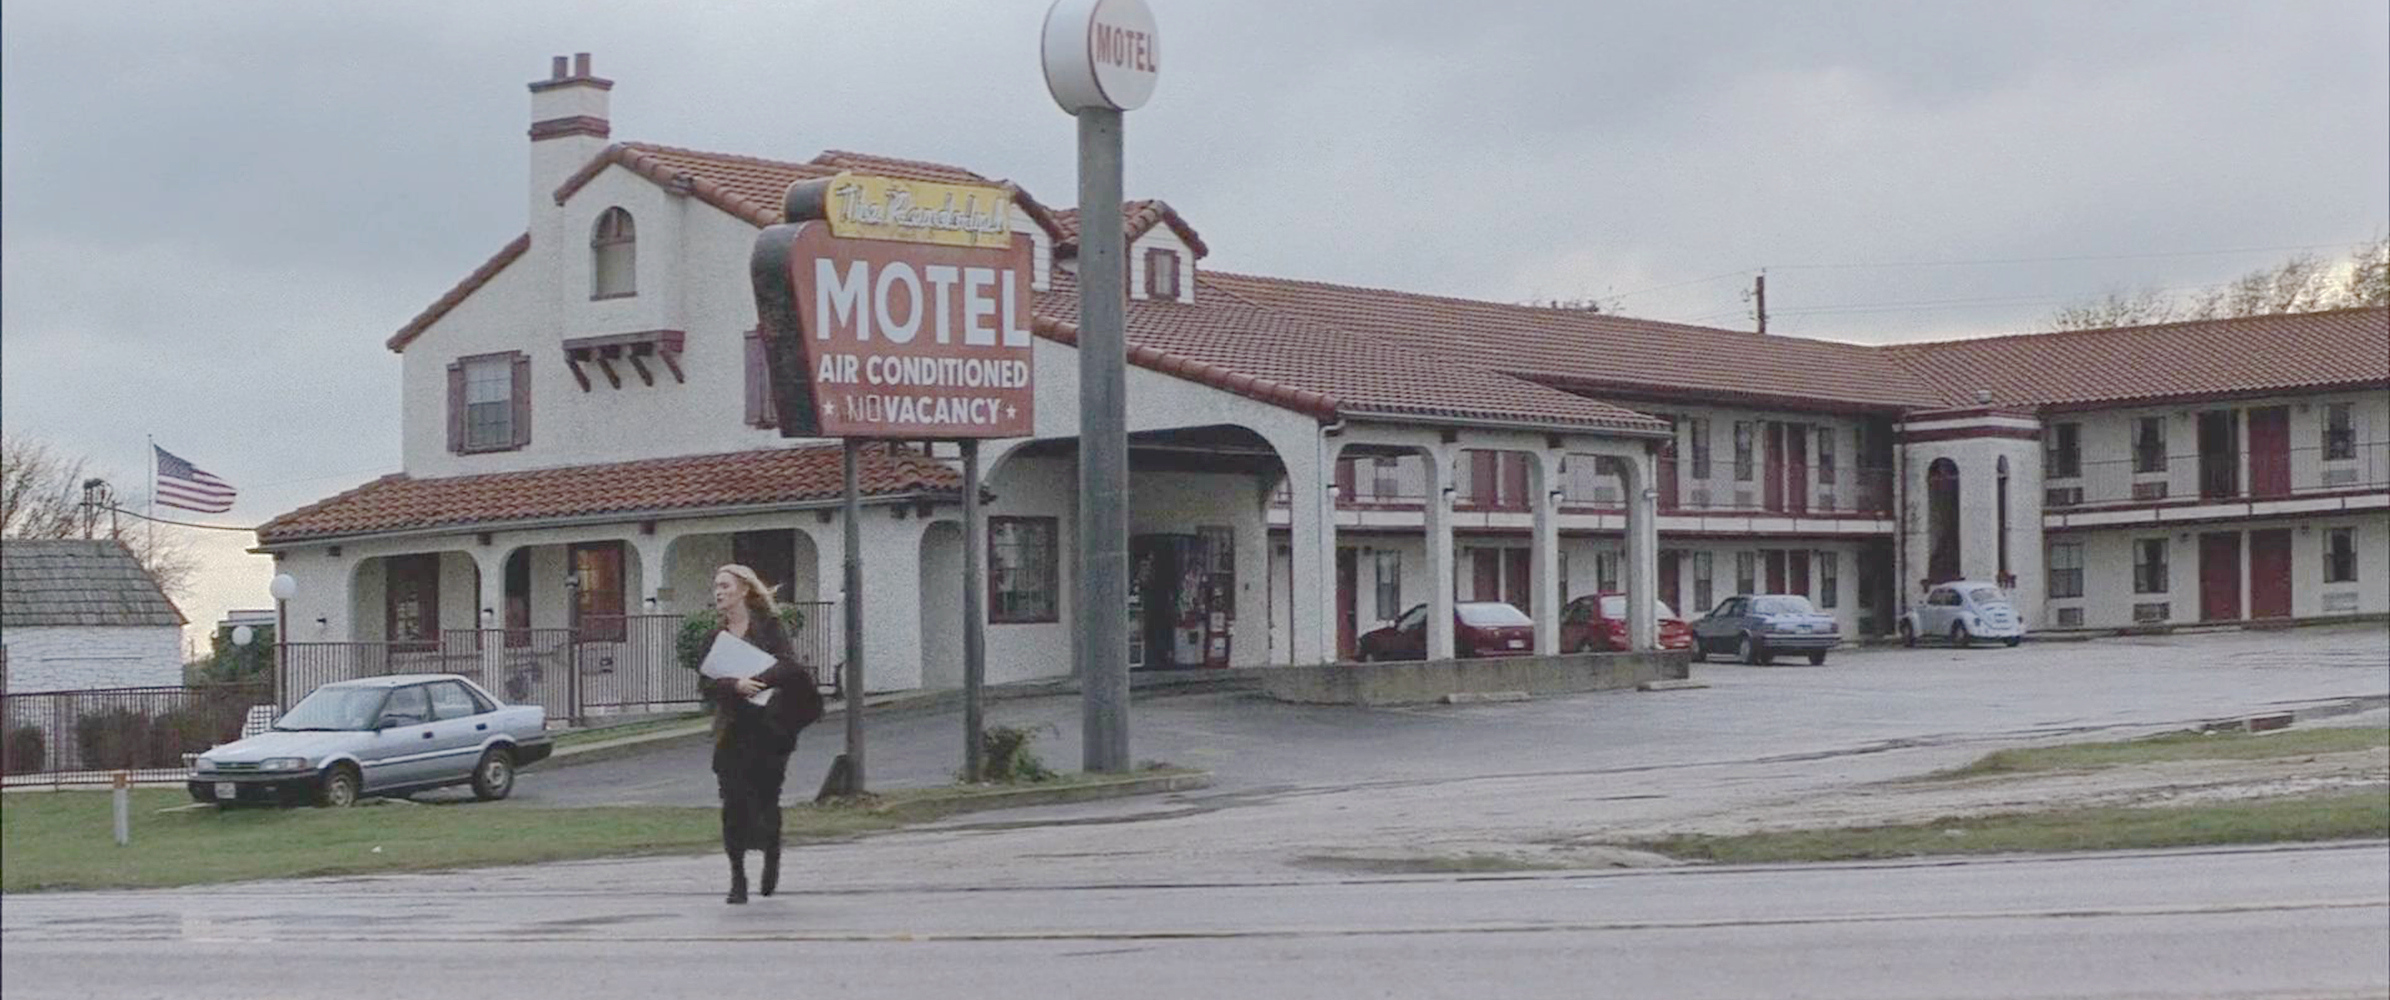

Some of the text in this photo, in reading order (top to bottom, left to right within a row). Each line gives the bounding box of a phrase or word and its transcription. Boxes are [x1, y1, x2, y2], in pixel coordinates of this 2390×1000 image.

[1096, 22, 1156, 73] MOTEL
[814, 258, 1032, 348] MOTEL
[817, 353, 1029, 389] AIR CONDITIONED
[846, 394, 1001, 425] NO VACANCY
